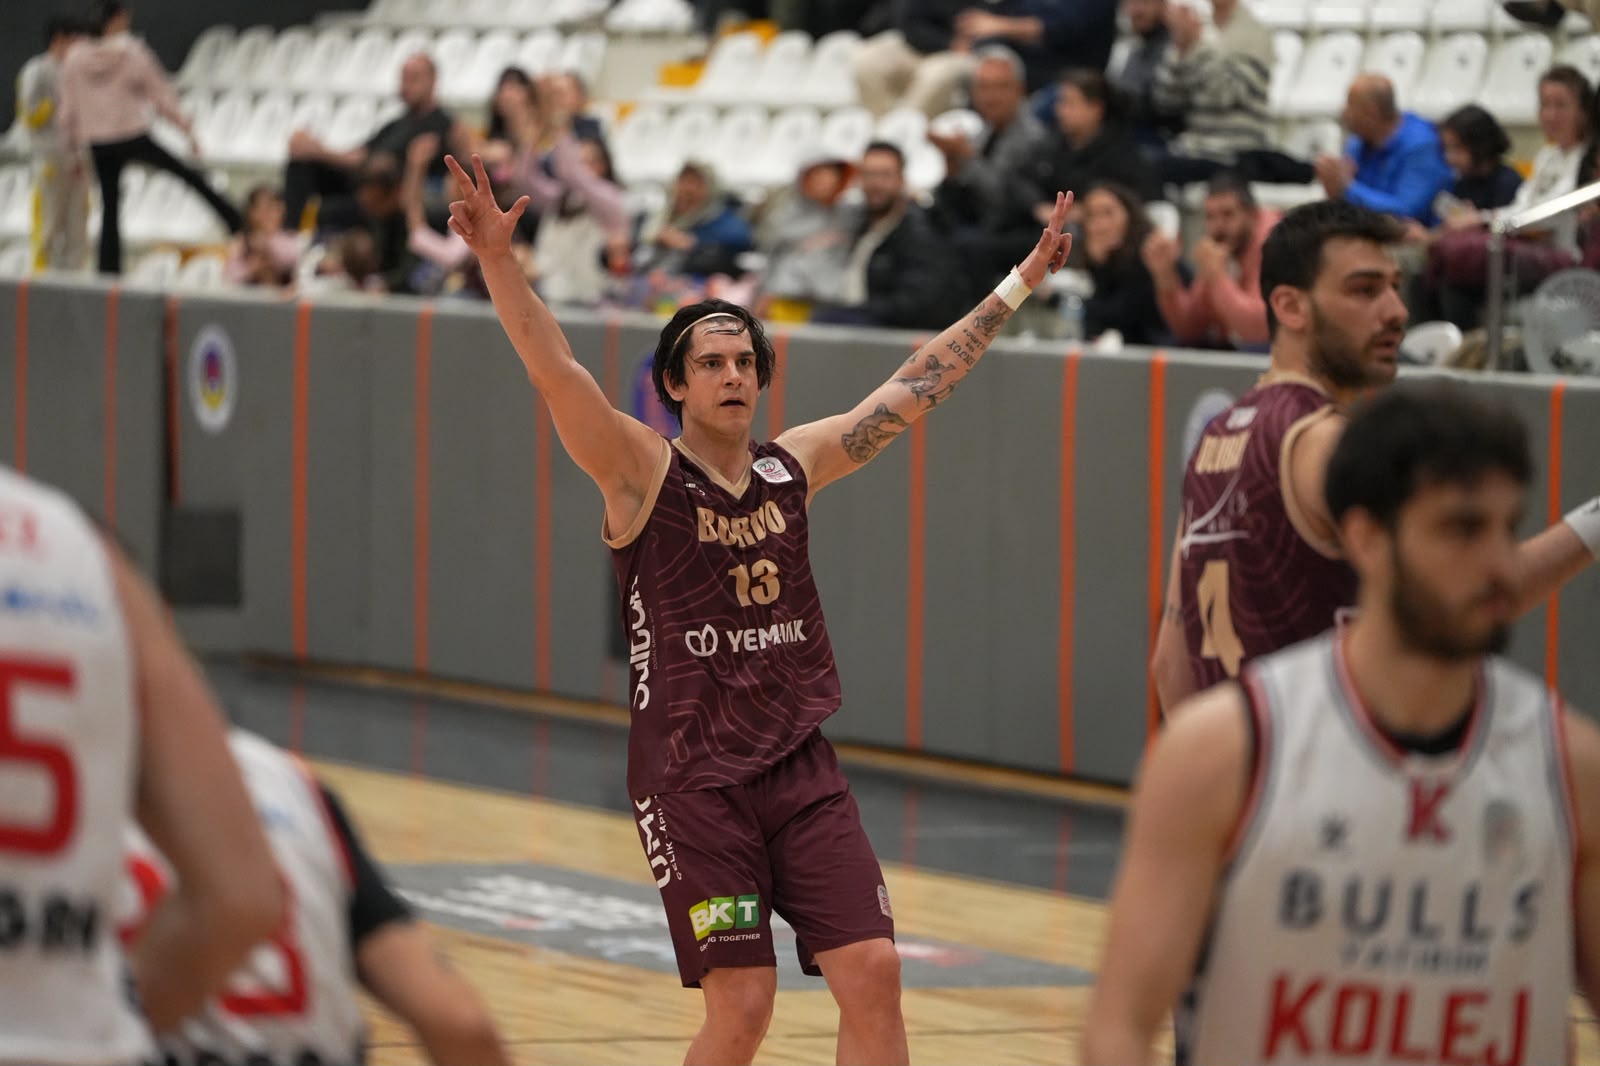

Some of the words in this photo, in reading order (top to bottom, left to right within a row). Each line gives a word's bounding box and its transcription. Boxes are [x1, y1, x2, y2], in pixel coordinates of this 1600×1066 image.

[946, 340, 976, 367] ENJOY
[696, 500, 786, 548] BORDO
[728, 558, 781, 607] 13
[1197, 560, 1245, 678] 4
[1405, 777, 1452, 845] K
[690, 900, 757, 935] BKT
[1277, 866, 1543, 945] BULLS
[718, 933, 760, 943] TOGETHER
[1263, 973, 1531, 1066] KOLEJ
